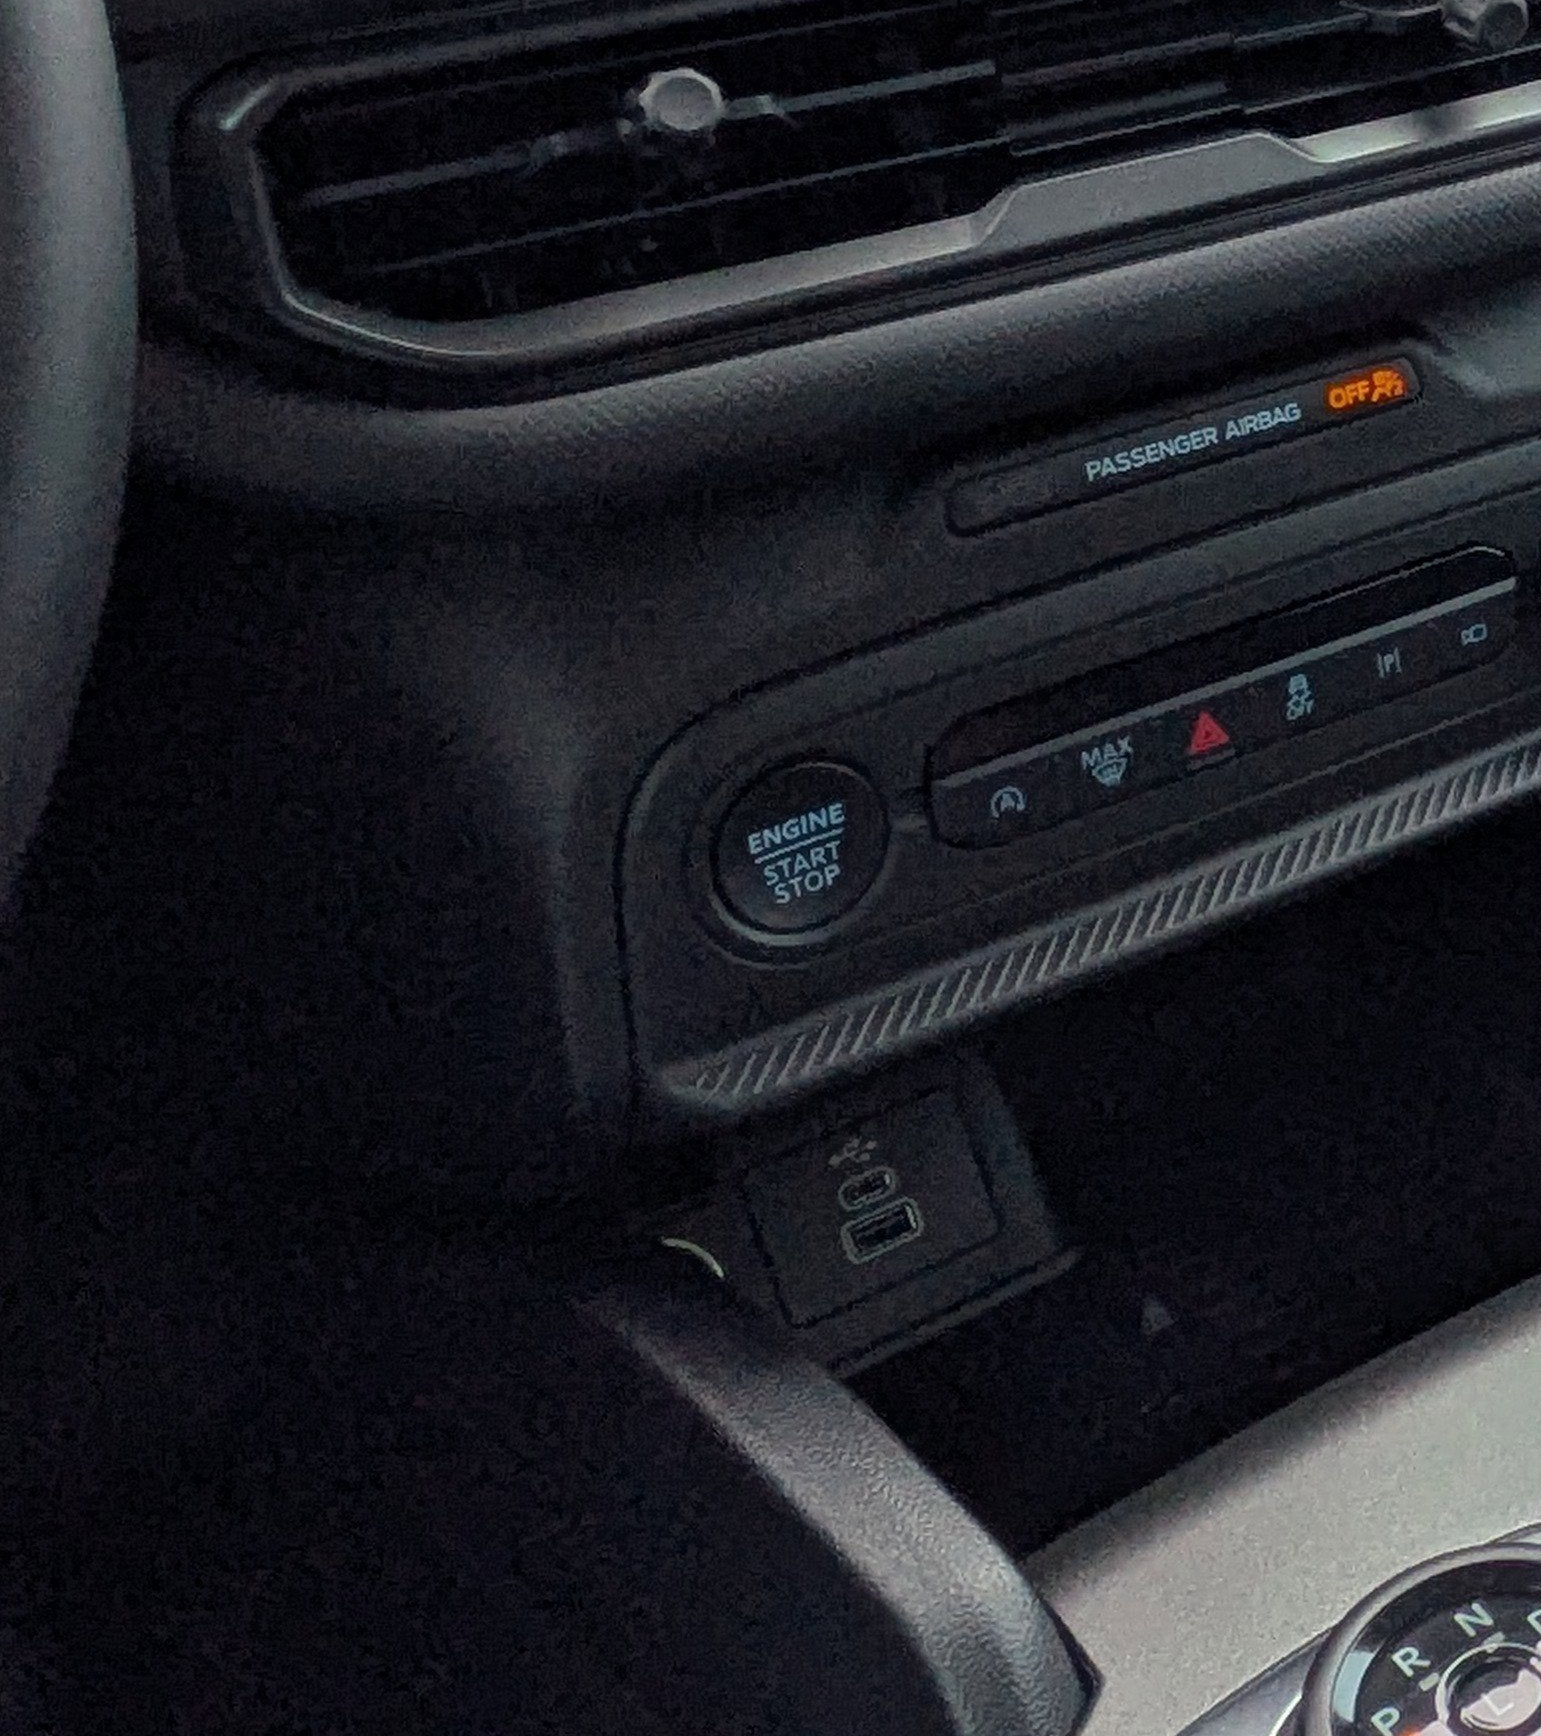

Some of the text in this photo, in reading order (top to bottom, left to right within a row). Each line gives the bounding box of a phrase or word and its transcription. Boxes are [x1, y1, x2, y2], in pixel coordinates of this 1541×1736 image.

[1328, 379, 1369, 409] OFF
[1085, 401, 1302, 482] PASSENGER AIRBAG
[1081, 735, 1134, 770] MAX
[746, 801, 846, 854] ENGINE
[763, 839, 841, 888] START
[773, 863, 841, 904] STOP
[1454, 1602, 1494, 1638] N
[1391, 1646, 1432, 1678] R
[1371, 1705, 1401, 1736] P
